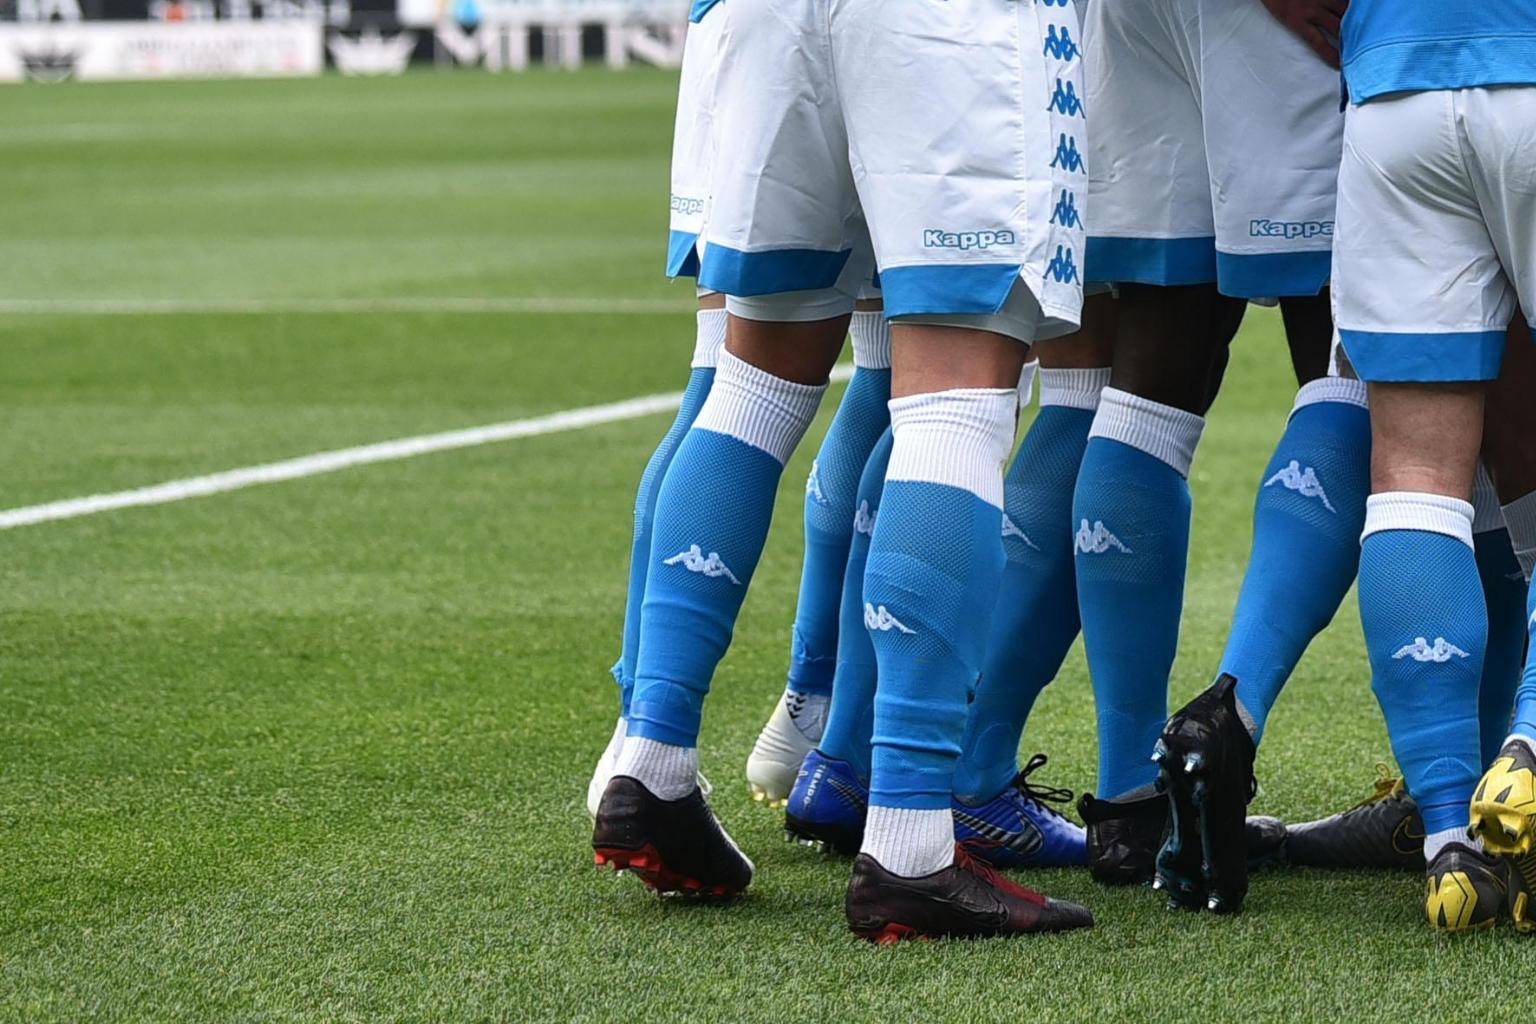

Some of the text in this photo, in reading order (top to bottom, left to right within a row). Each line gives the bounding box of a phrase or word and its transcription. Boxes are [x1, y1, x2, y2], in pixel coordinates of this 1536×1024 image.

[671, 193, 705, 216] appa
[923, 229, 1015, 251] Kappa
[1250, 219, 1336, 239] Kappa
